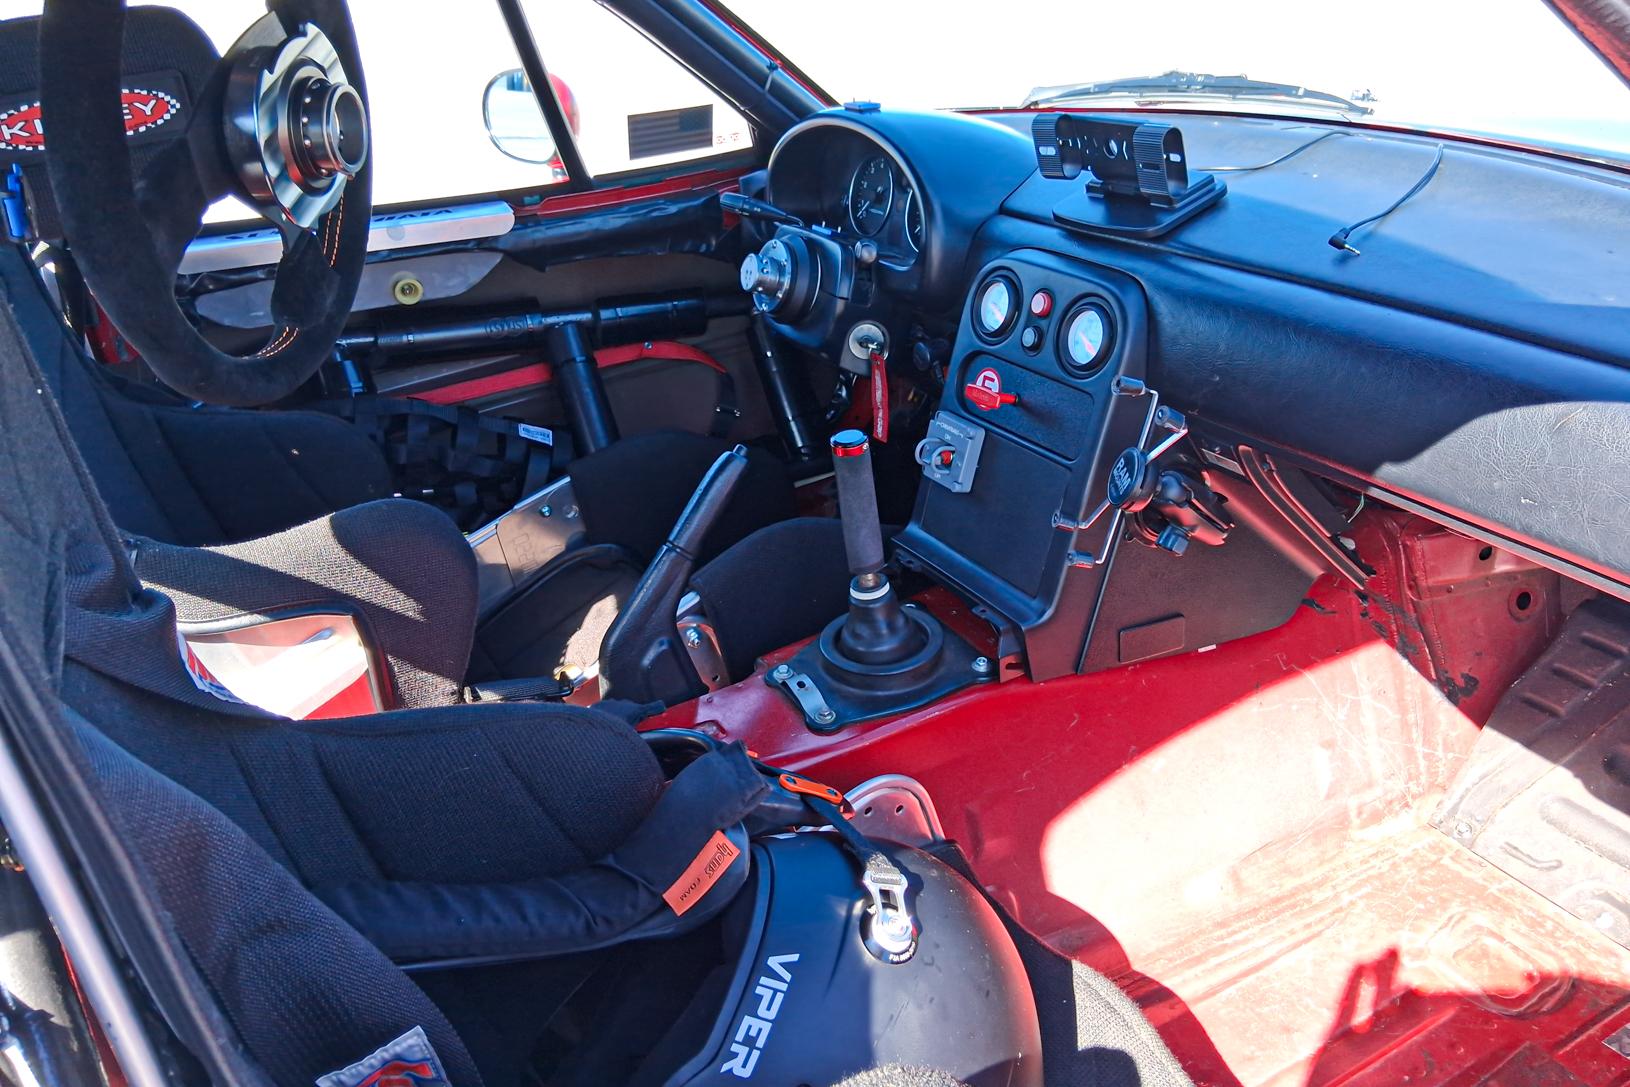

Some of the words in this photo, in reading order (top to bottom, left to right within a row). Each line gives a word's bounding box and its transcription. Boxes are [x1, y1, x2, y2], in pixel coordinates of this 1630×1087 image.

[1, 99, 157, 140] KIEY
[1113, 457, 1131, 491] RAM
[720, 953, 800, 1079] VIPER
